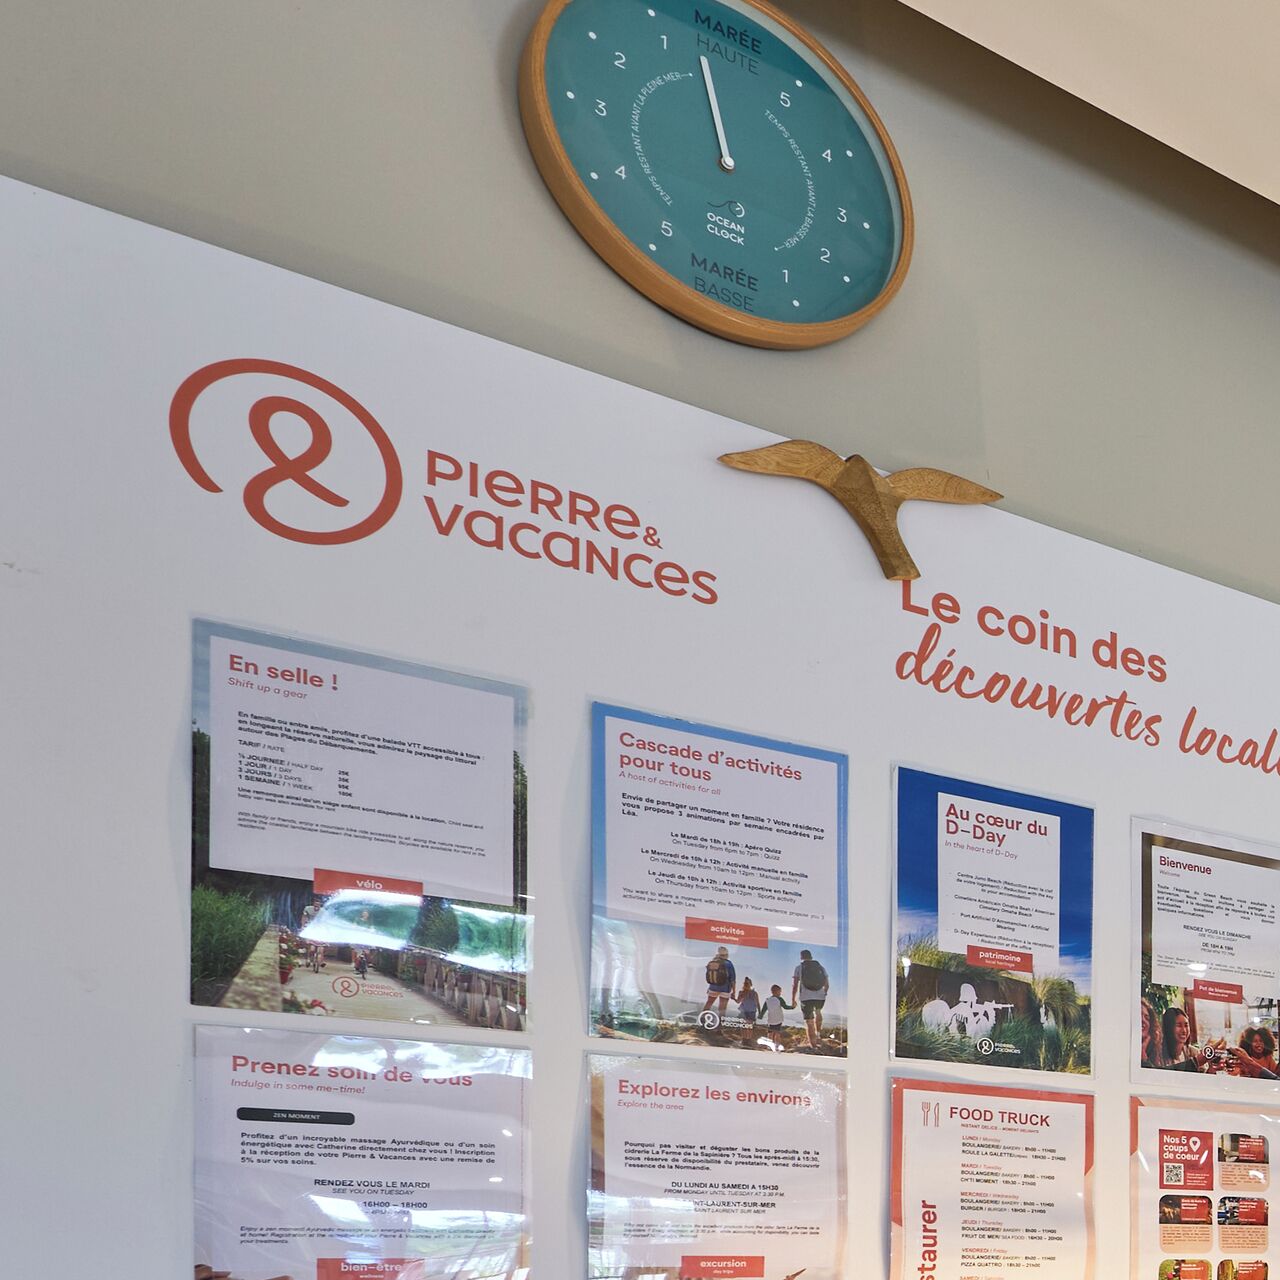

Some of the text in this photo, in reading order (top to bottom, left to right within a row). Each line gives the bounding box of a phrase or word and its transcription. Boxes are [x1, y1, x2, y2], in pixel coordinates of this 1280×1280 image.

[694, 8, 763, 55] MARÉE
[660, 35, 668, 50] 1
[614, 52, 626, 69] 2
[696, 36, 759, 75] HAUTE
[663, 71, 681, 83] MER
[595, 100, 607, 117] 3
[780, 92, 791, 108] 5
[632, 102, 641, 132] AVANT
[632, 133, 652, 174] RESTANT
[765, 109, 790, 138] TEMPS
[788, 139, 812, 177] RESTANT
[807, 179, 816, 207] AVANT
[822, 149, 832, 162] 4
[615, 165, 627, 180] 4
[649, 175, 672, 206] TEMPS
[707, 212, 745, 235] OCEAN
[837, 207, 847, 223] 3
[661, 221, 672, 237] 5
[707, 224, 745, 246] CLOCK
[820, 248, 831, 263] 2
[690, 253, 759, 292] MARÉE
[782, 269, 789, 283] 1
[695, 276, 754, 313] BASSE
[901, 580, 1167, 683] Le coin des
[229, 654, 259, 675] En
[266, 666, 324, 688] selle
[227, 677, 308, 699] Shift up a gear
[895, 622, 1162, 746] découvertes
[618, 731, 703, 761] Cascade
[620, 754, 712, 781] pour tous
[627, 772, 647, 783] host
[648, 776, 657, 784] of
[659, 778, 696, 792] activities
[698, 784, 709, 793] for
[711, 786, 721, 796] all
[945, 803, 1047, 836] Au cœur du
[946, 819, 1006, 847] D-Day
[953, 842, 965, 850] the
[966, 843, 985, 853] heart
[995, 849, 1018, 860] D-Day
[1159, 856, 1212, 875] Bienvenue
[356, 878, 383, 891] vélo
[710, 924, 745, 936] activités
[979, 950, 1021, 963] patrimoine
[232, 1055, 320, 1077] Prenez
[384, 1066, 413, 1083] de
[231, 1079, 271, 1090] Indulge
[273, 1081, 283, 1089] in
[618, 1079, 812, 1107] Explorez les environs
[617, 1100, 648, 1110] Explore
[650, 1102, 664, 1110] the
[949, 1106, 1050, 1127] FOOD TRUCK
[1163, 1135, 1179, 1143] Nos
[1163, 1144, 1188, 1152] coups
[1163, 1151, 1174, 1159] de
[314, 1178, 430, 1189] RENDEZ VOUS LE MARDI
[401, 1201, 427, 1209] 18H00
[700, 1259, 747, 1268] excursion
